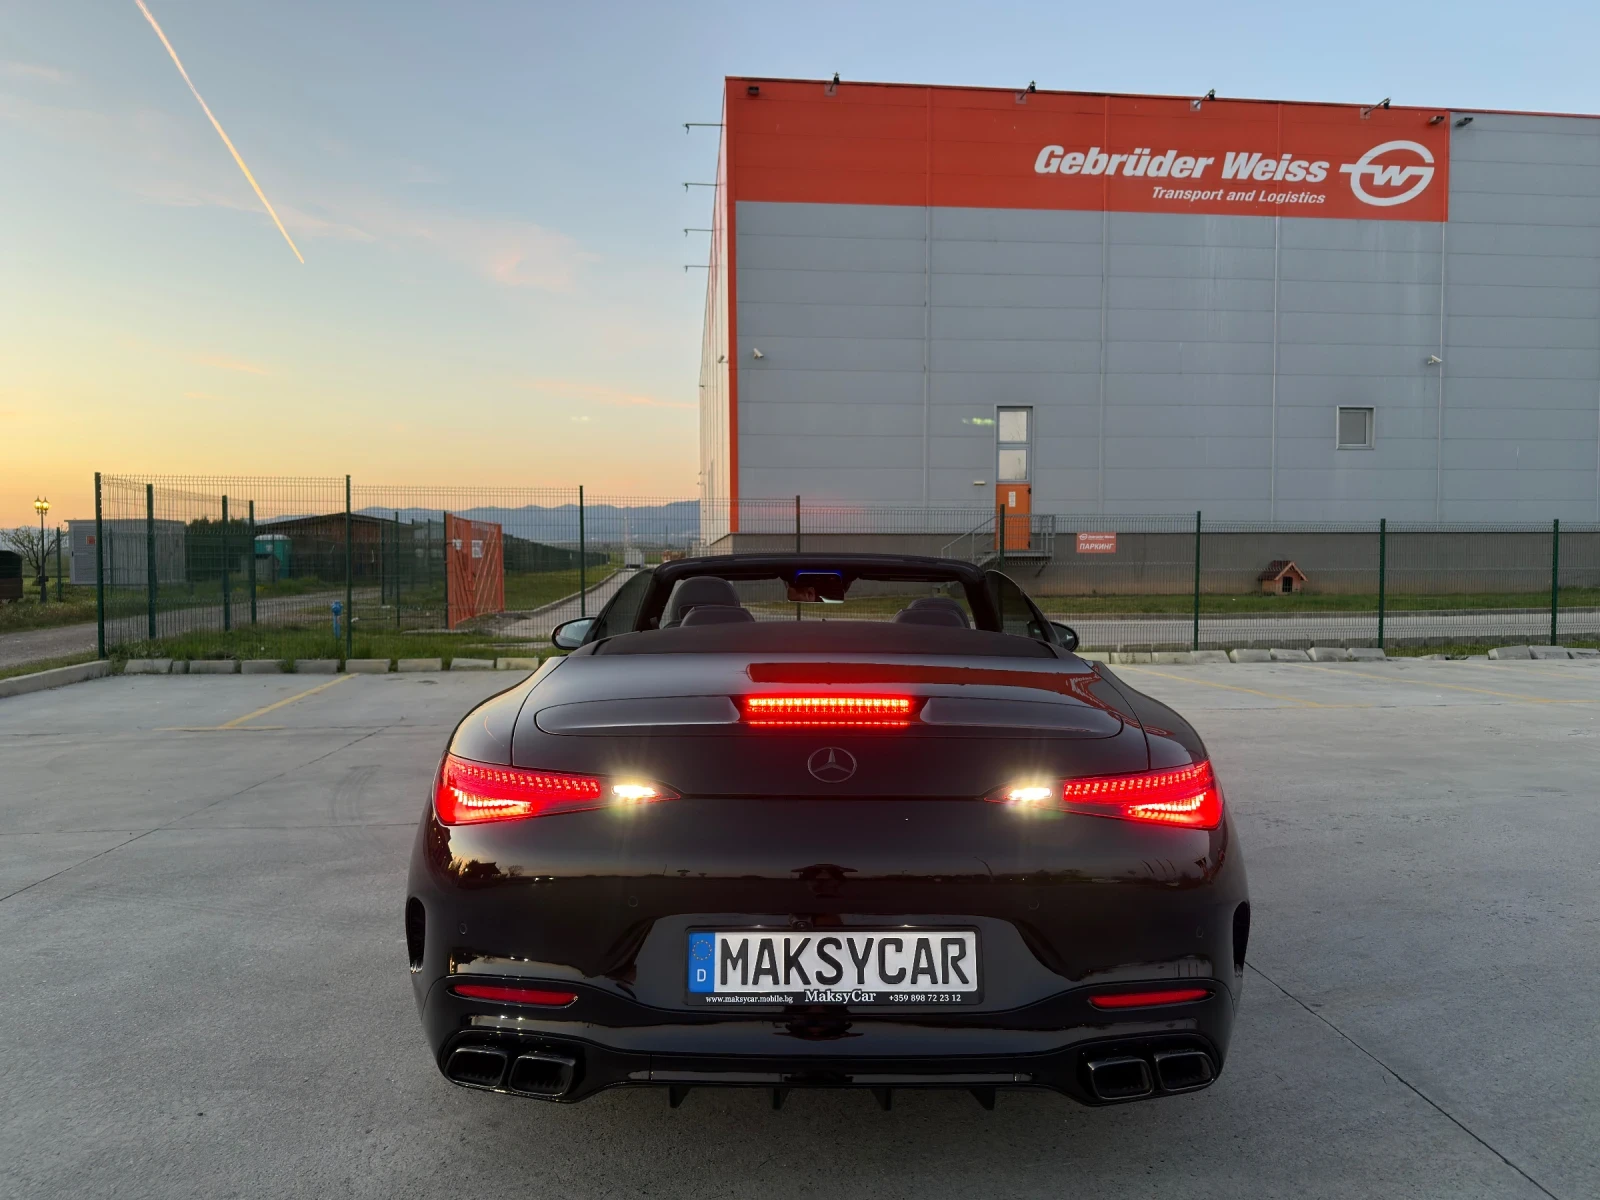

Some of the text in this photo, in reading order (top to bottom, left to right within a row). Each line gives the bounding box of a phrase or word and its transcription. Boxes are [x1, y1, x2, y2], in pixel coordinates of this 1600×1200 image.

[1034, 145, 1330, 183] Gebrüder Weiss
[1152, 186, 1326, 205] Transport and Logistics
[720, 937, 970, 986] MAKSYCAR
[696, 968, 707, 982] D
[705, 994, 794, 1005] www.maksycar.mobile.bg
[804, 989, 877, 1004] MaksyCar
[888, 994, 962, 1002] +359 898 72 23 12
